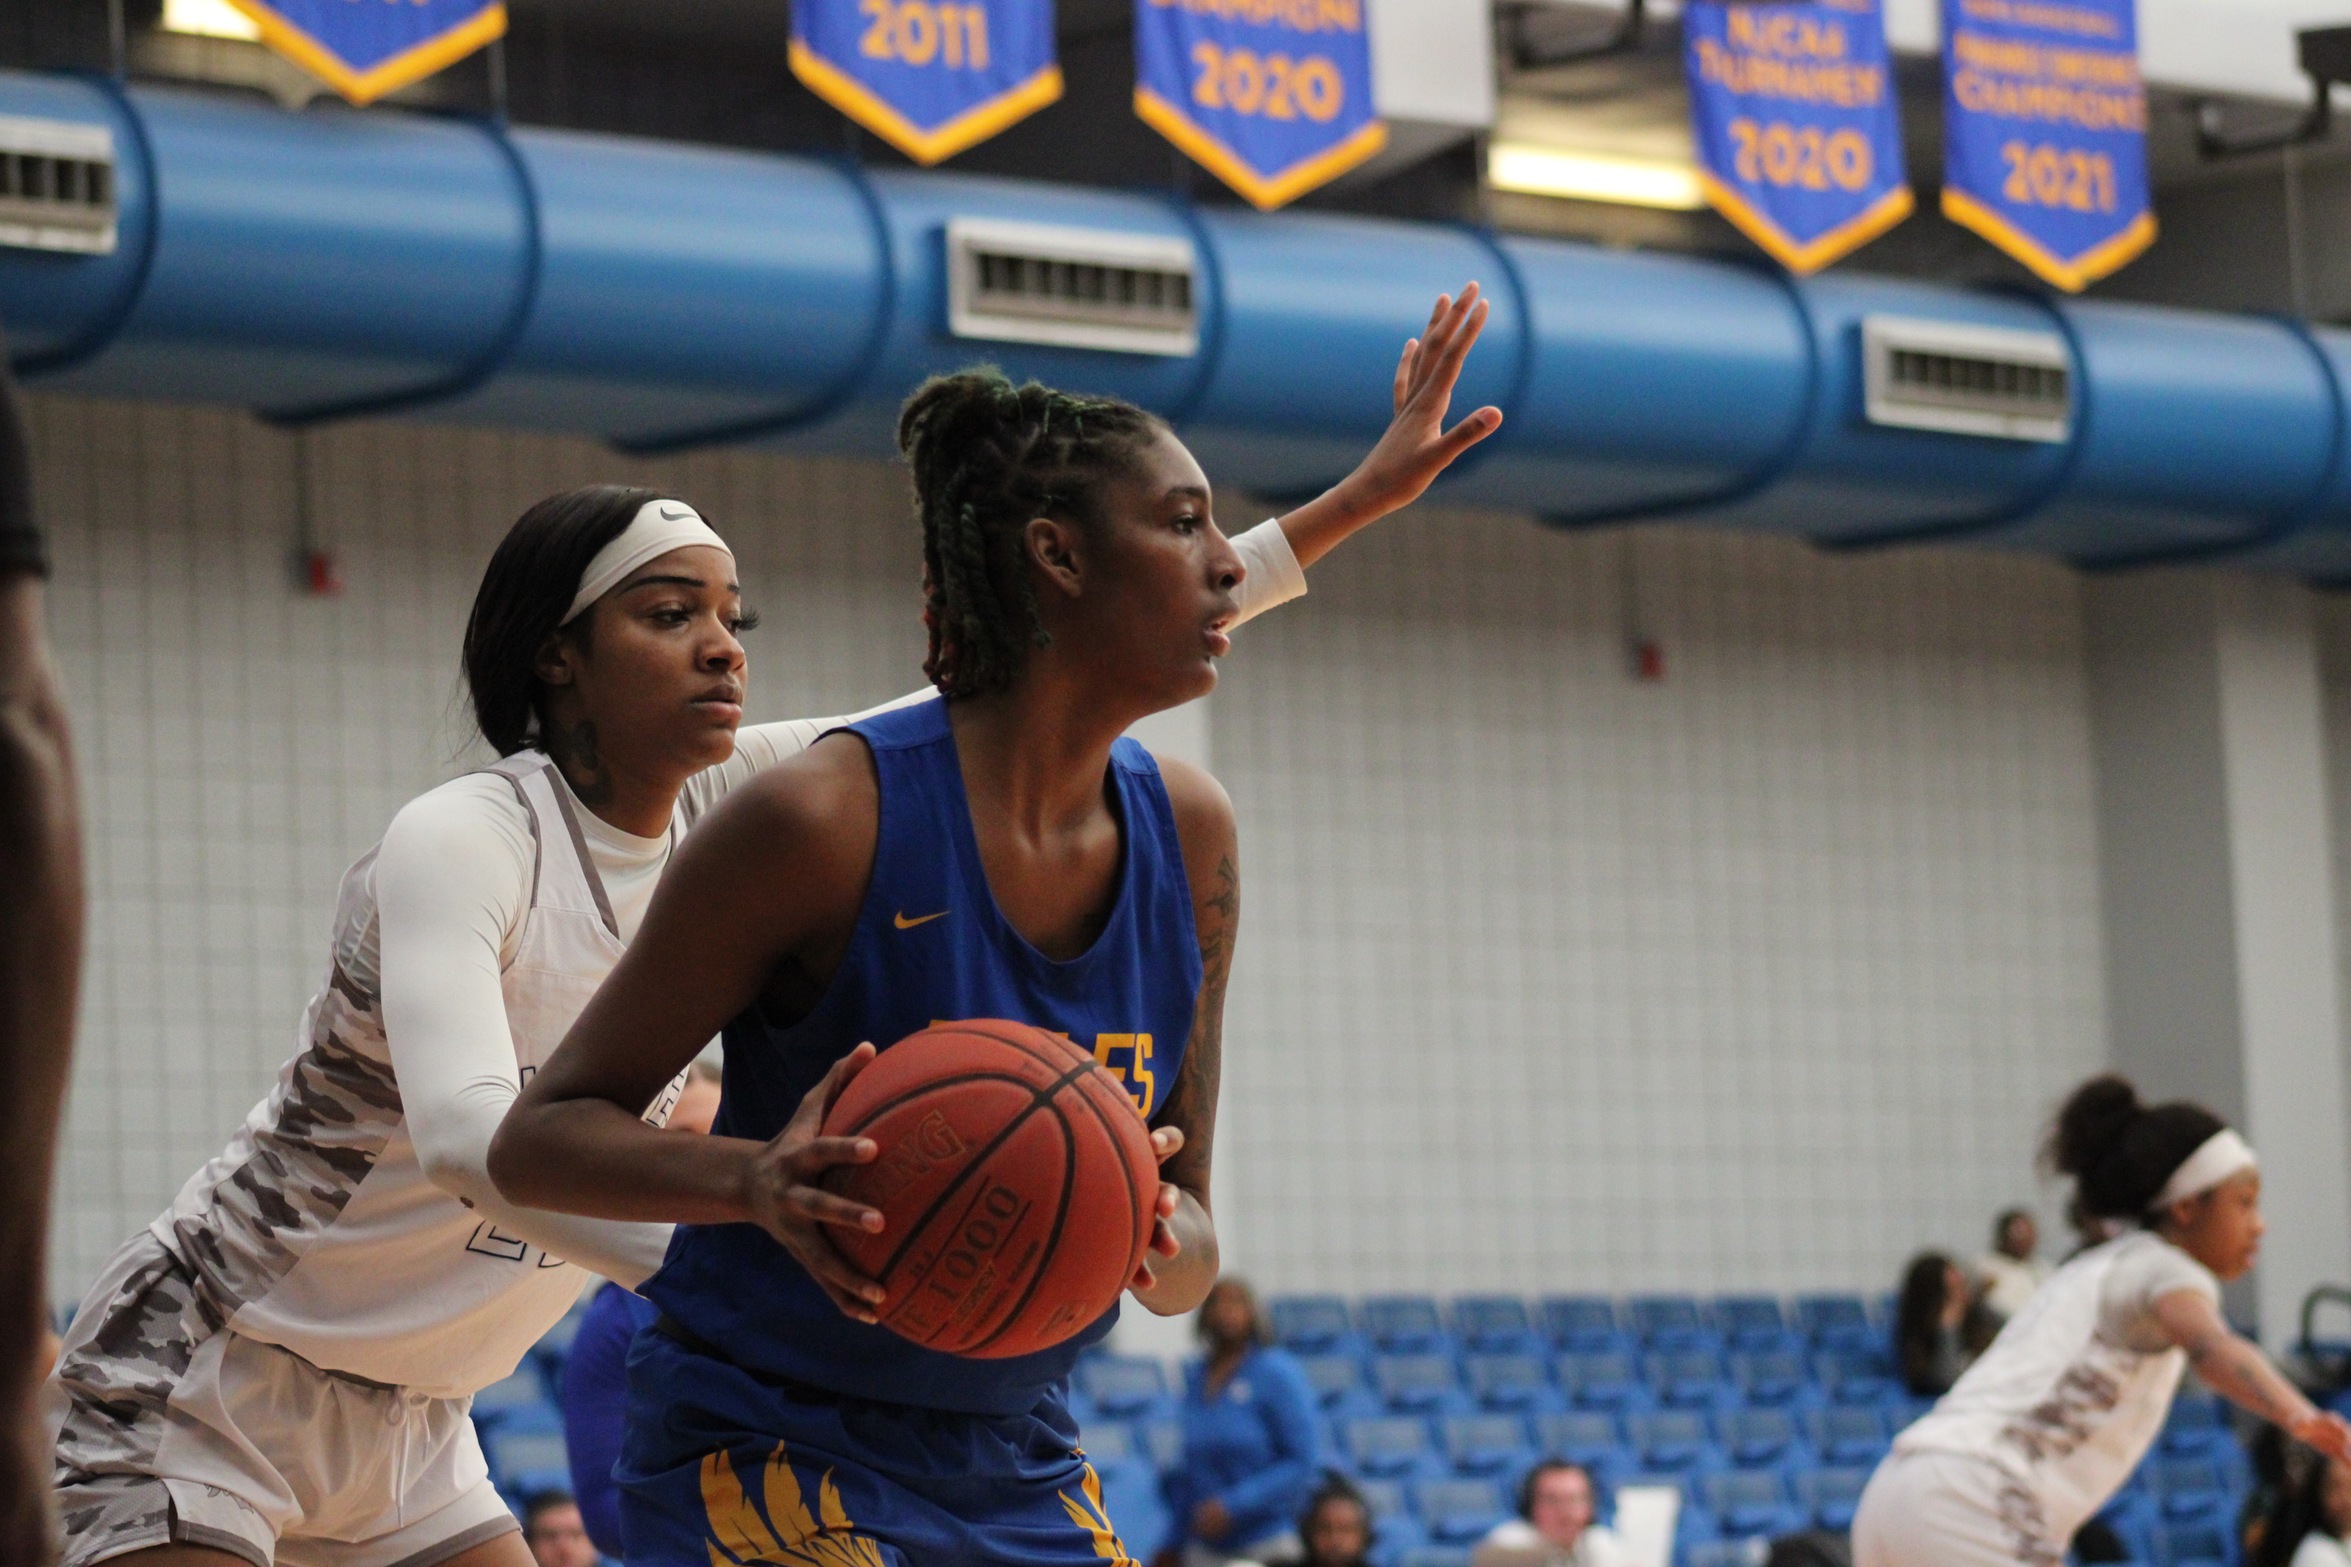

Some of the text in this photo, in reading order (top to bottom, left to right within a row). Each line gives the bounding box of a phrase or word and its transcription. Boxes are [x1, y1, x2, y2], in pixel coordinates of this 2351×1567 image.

[859, 0, 989, 70] 2011
[1192, 41, 1343, 123] 2020
[1729, 117, 1872, 190] 2020
[2002, 140, 2115, 213] 2021
